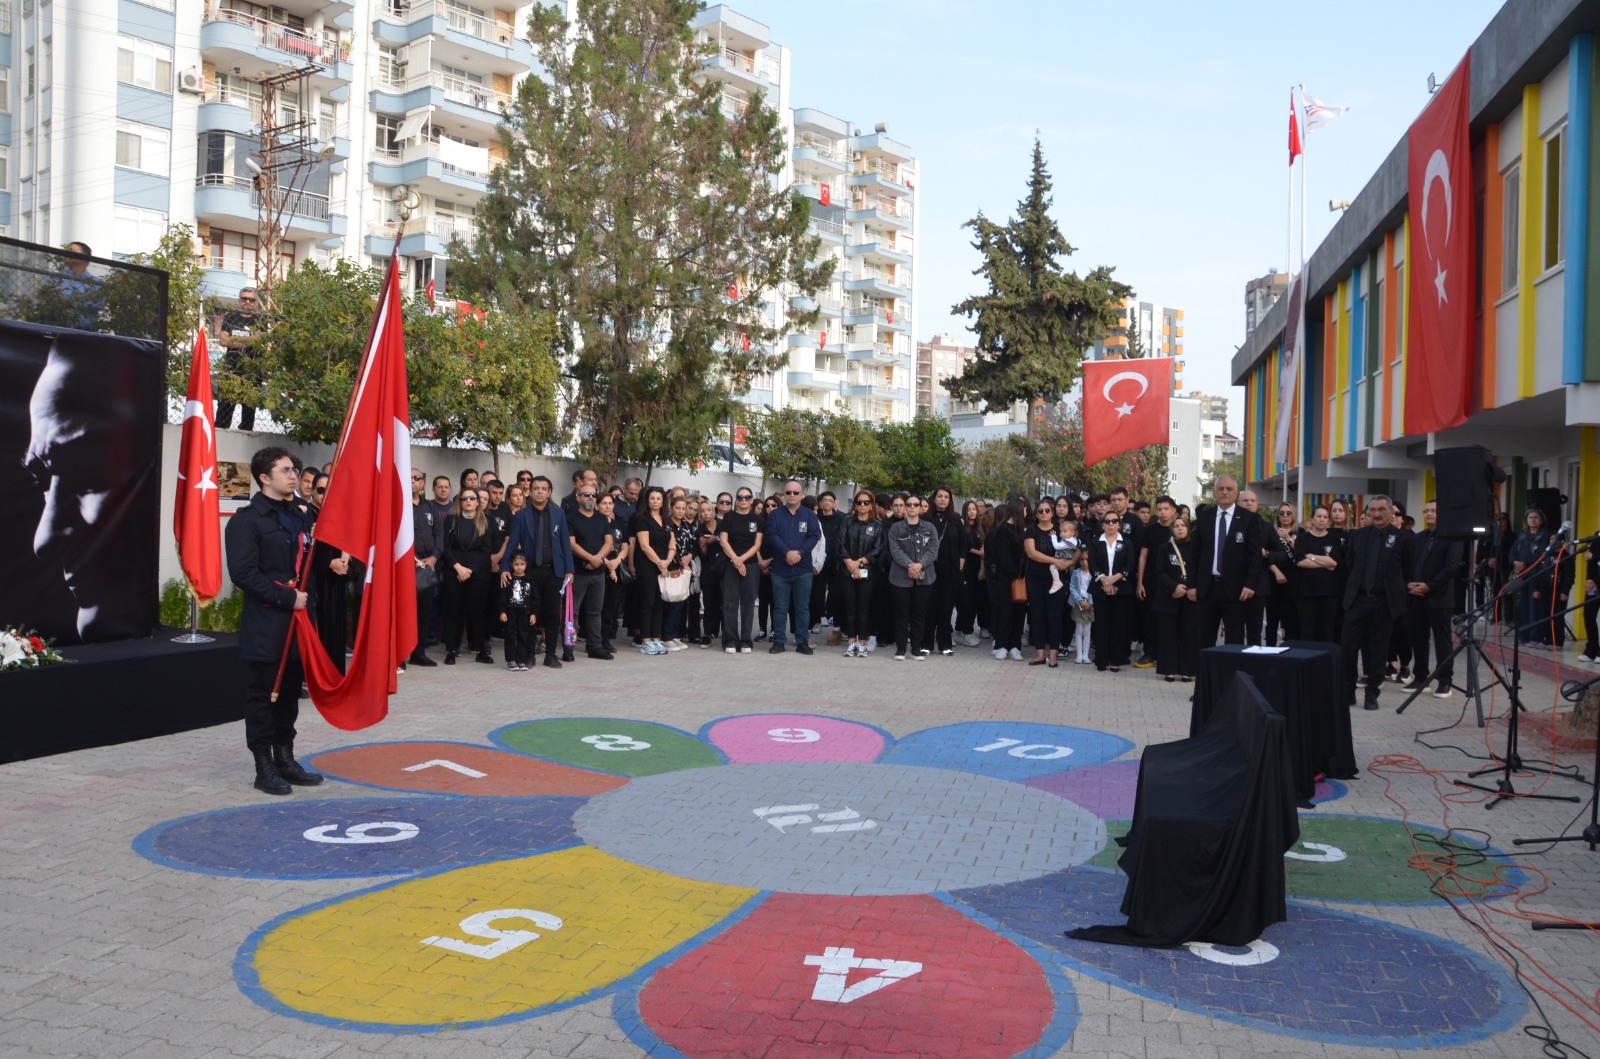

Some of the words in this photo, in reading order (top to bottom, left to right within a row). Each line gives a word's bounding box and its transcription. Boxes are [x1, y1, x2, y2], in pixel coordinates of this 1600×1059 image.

[580, 734, 652, 752] 8
[767, 727, 821, 744] 9
[973, 737, 1074, 760] 10
[401, 758, 488, 779] 7
[302, 821, 420, 844] 6
[419, 908, 564, 960] 5
[803, 946, 923, 1004] 4
